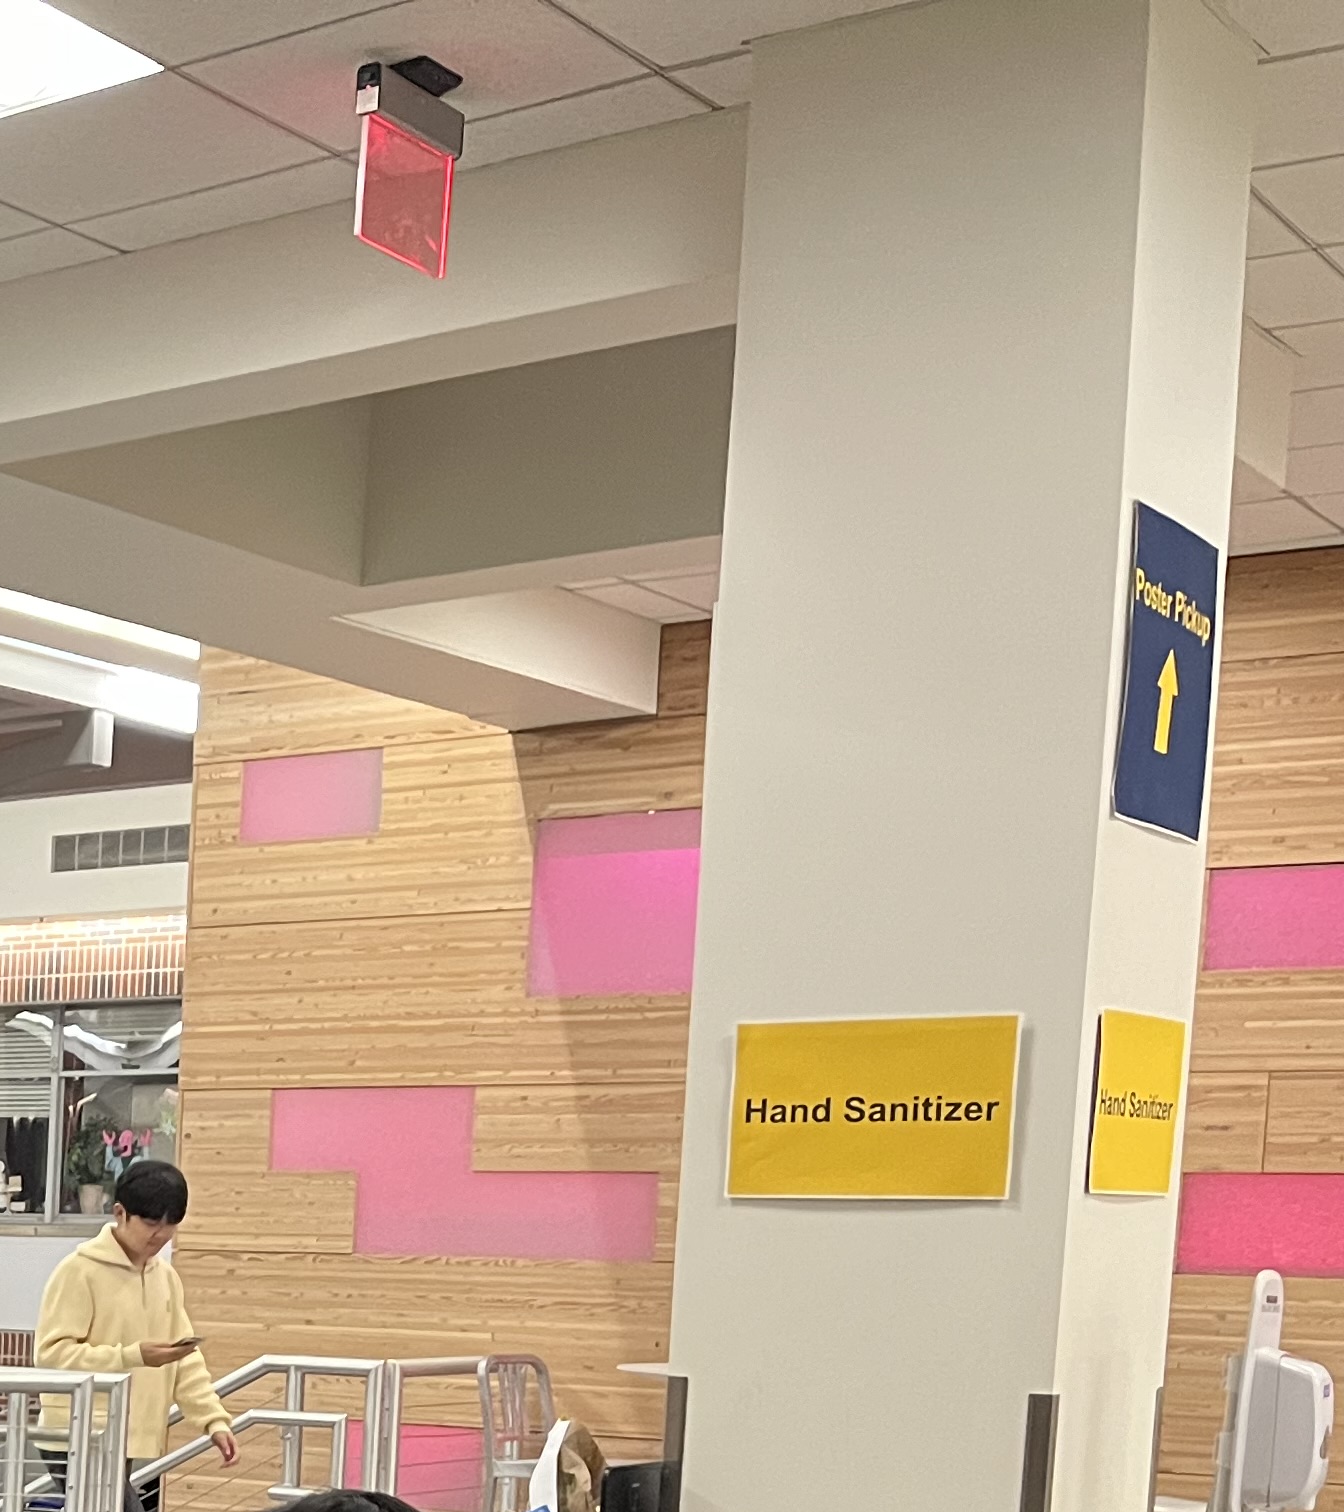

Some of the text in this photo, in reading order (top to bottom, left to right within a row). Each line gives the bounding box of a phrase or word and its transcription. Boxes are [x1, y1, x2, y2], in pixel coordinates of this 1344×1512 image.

[1136, 567, 1211, 647] Poster Pickup
[744, 1094, 1000, 1125] Hand Sanitizer
[1098, 1088, 1174, 1121] Hand Sanitizer
